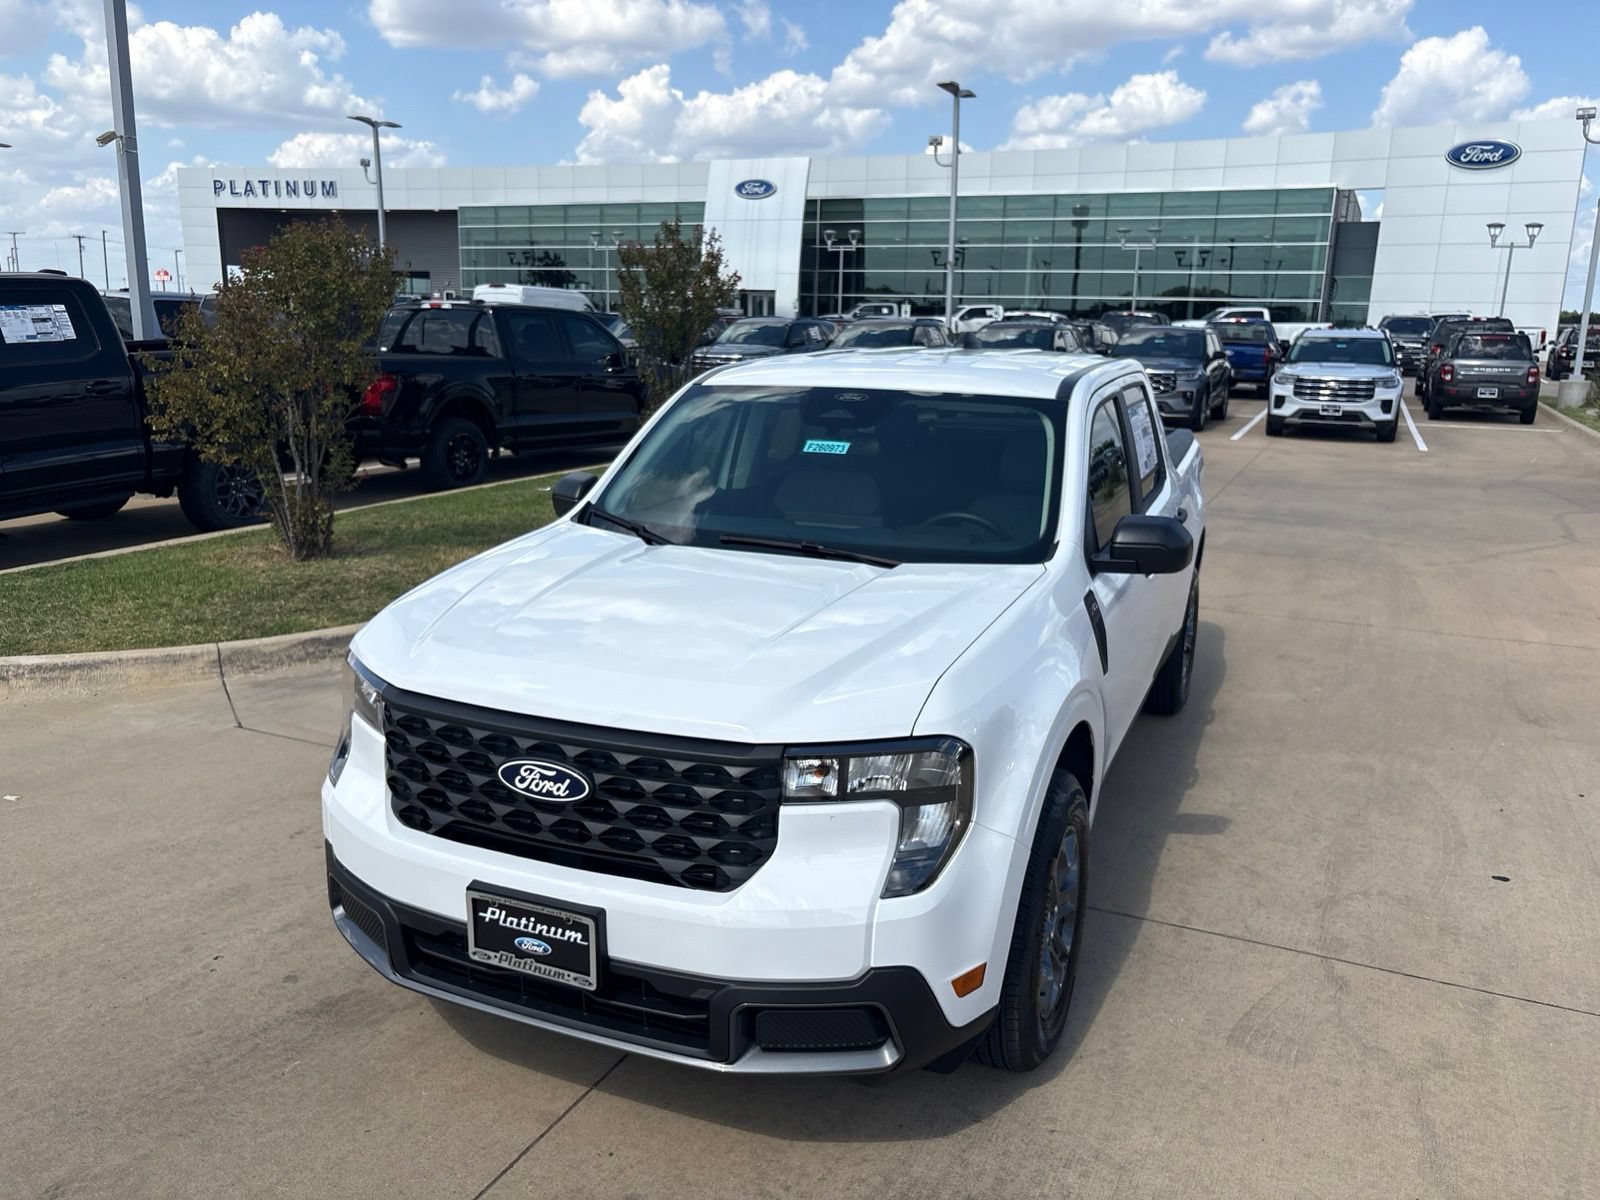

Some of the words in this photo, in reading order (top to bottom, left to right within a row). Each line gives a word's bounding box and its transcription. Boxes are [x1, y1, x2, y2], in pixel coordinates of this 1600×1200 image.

[1460, 145, 1504, 162] Ford
[213, 179, 337, 198] PLATINUM
[741, 182, 767, 194] Ford
[807, 443, 846, 453] F260973
[515, 765, 571, 797] Ford
[478, 906, 589, 946] Platinum
[520, 940, 545, 953] Ford
[498, 952, 570, 982] Platinum
